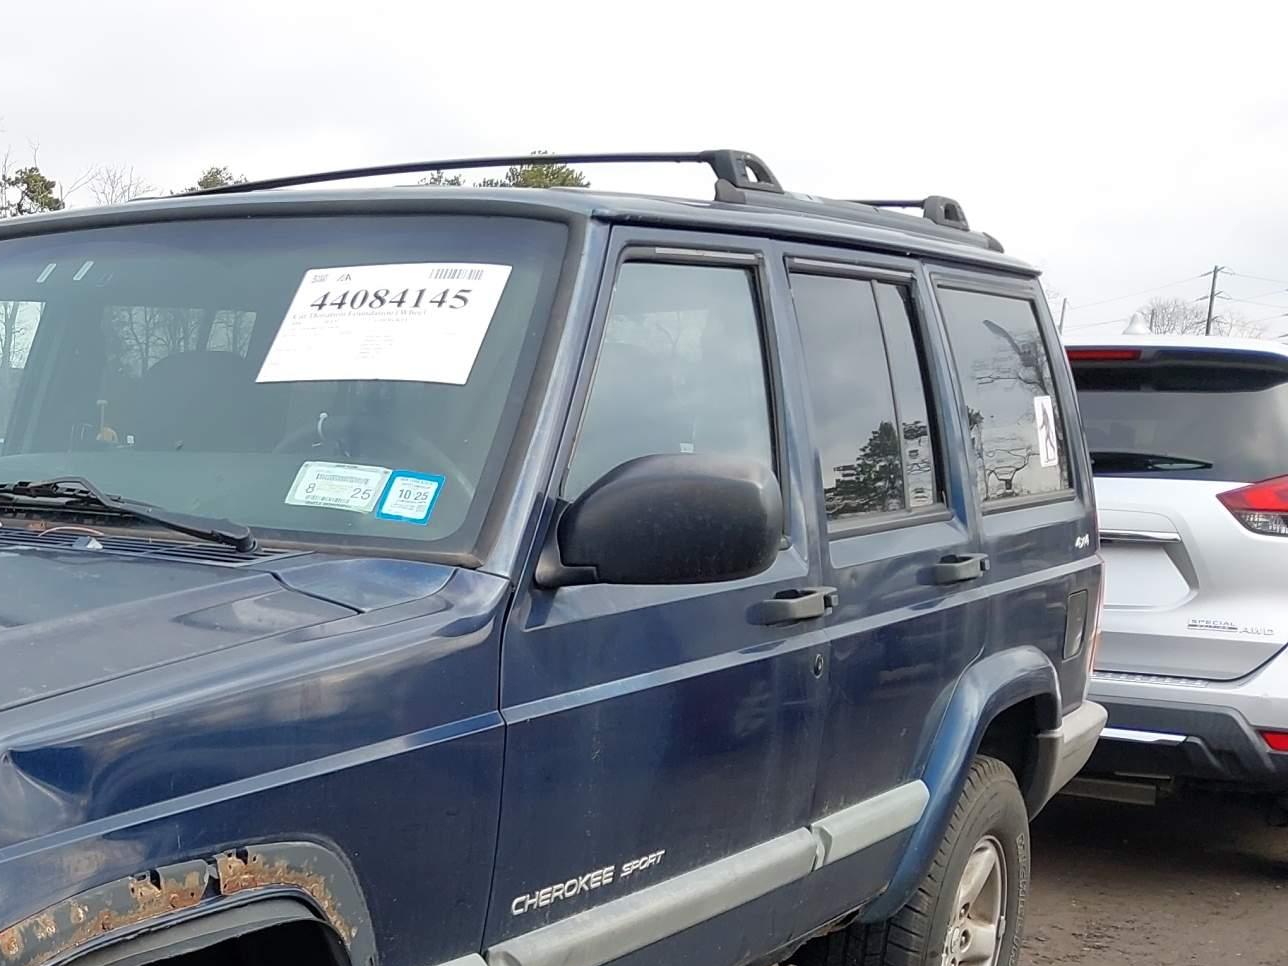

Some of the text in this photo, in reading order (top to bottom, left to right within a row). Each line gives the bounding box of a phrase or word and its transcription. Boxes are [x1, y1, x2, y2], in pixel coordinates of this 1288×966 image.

[309, 287, 473, 311] 44084145
[305, 482, 316, 494] 8
[350, 487, 372, 500] 25
[398, 489, 430, 501] 10 25
[511, 849, 666, 916] CHEROKEE SPORT
